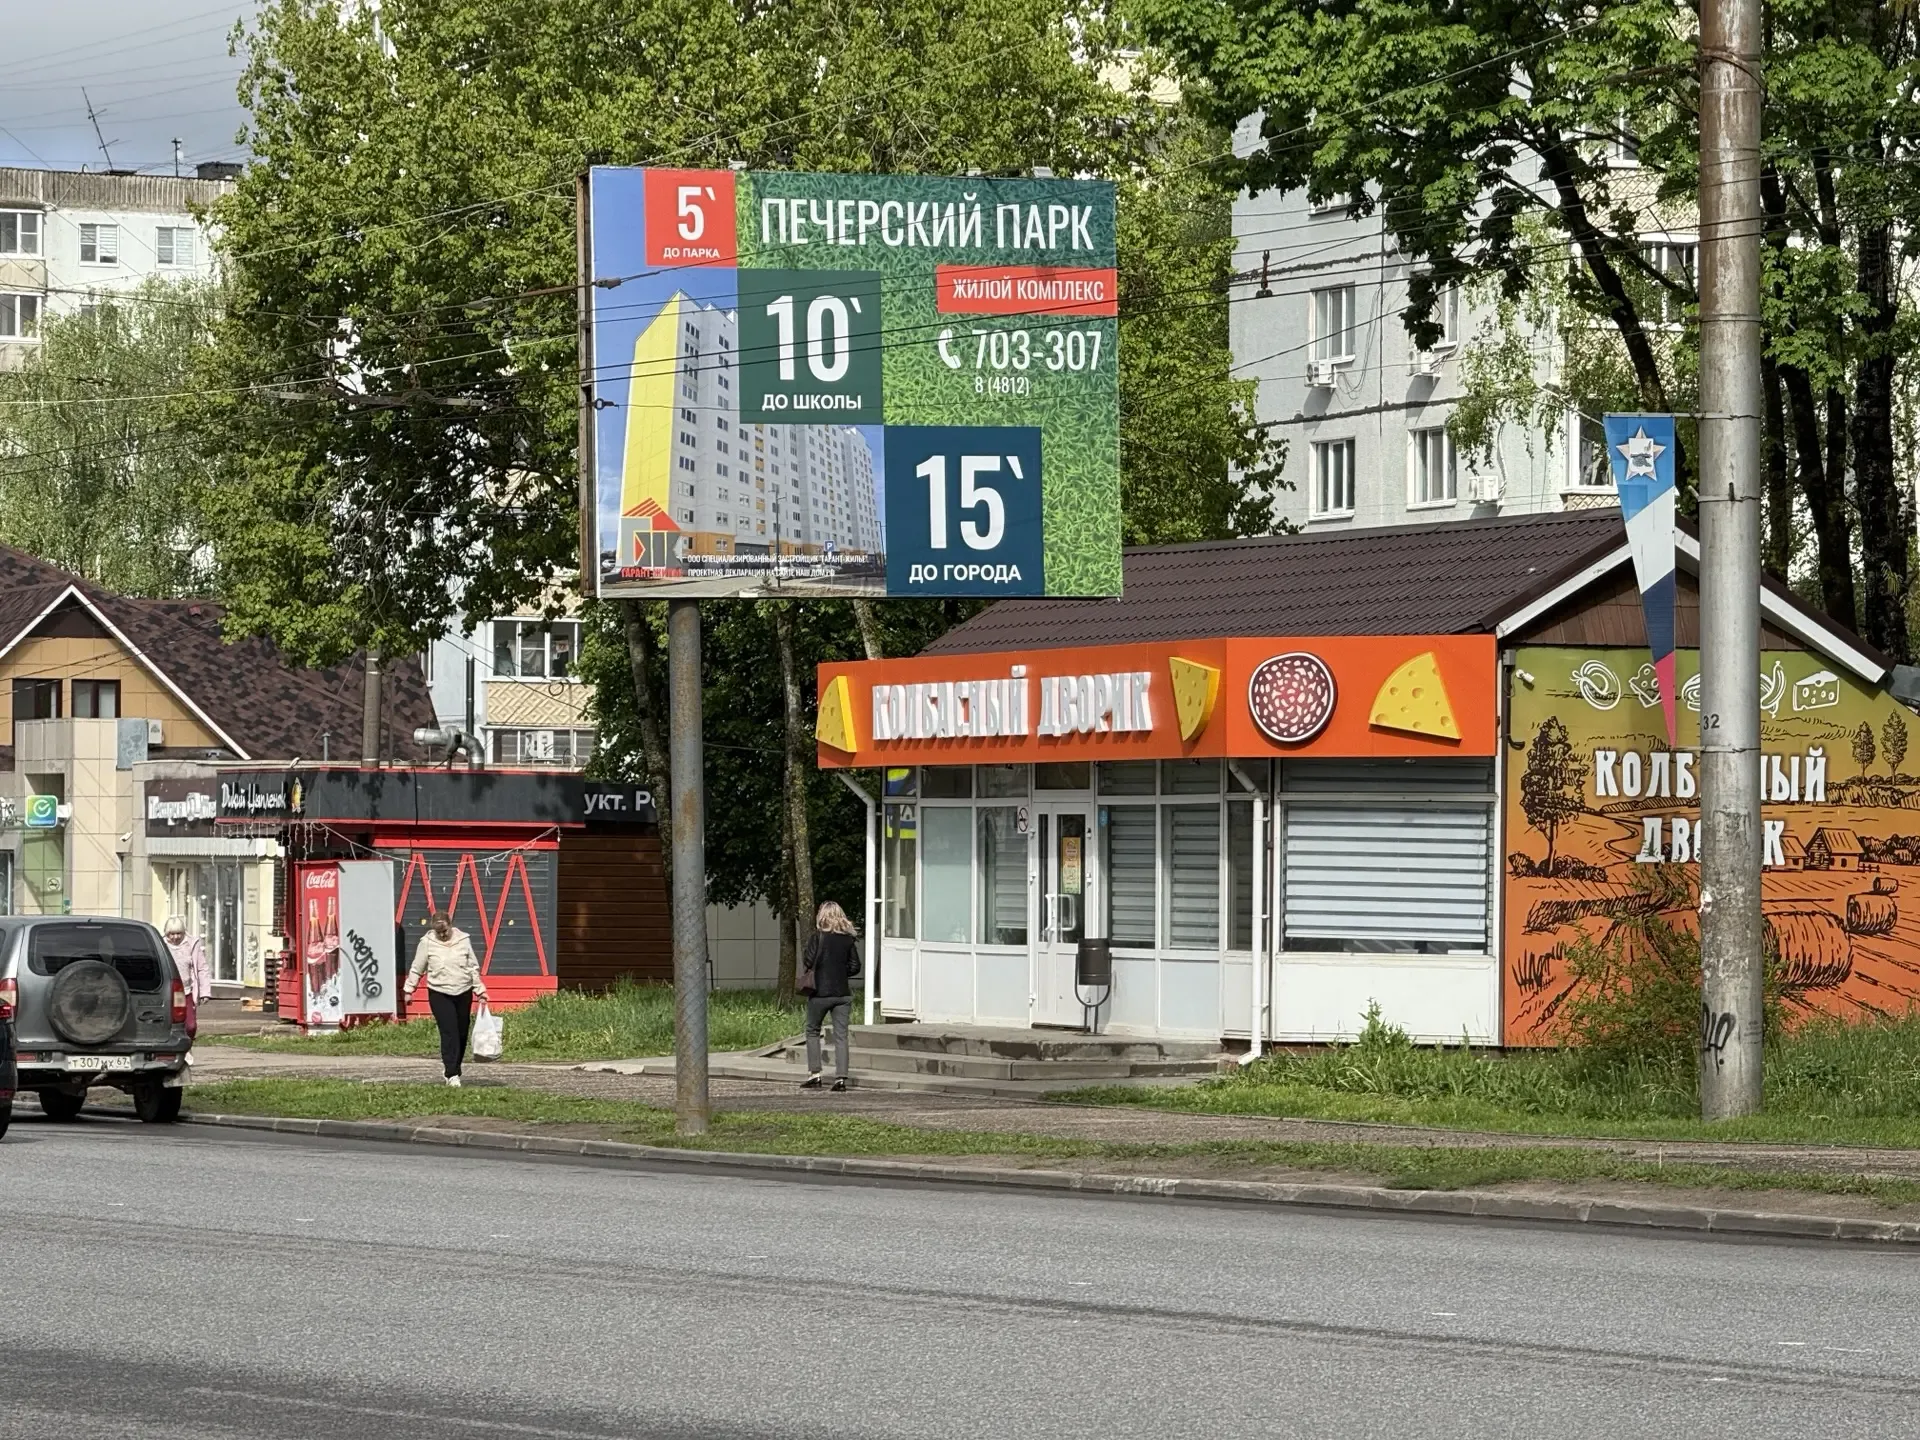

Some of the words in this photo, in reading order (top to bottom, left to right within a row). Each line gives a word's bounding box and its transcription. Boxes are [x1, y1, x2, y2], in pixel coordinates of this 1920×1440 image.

[761, 192, 982, 249] ПЕЧЕРСКИЙ
[996, 203, 1095, 251] ПАРК
[663, 247, 680, 259] ДО
[683, 247, 720, 259] ПАРКА
[952, 275, 1012, 301] ЖИЛОЙ
[1017, 279, 1105, 302] КОМПЛЕКС
[972, 328, 1103, 372] 703-307
[974, 376, 985, 393] 8
[987, 375, 1030, 398] (4812)
[762, 394, 789, 411] ДО
[793, 393, 863, 410] ШКОЛЫ
[687, 555, 701, 563] ООО
[701, 552, 776, 565] СПЕЦИАЛИЗИРОВАННЫЙ
[687, 568, 723, 577] ПРОЕКТНАЯ
[724, 568, 765, 578] ДЕКЛАРАЦИЯ
[909, 564, 938, 584] ДО
[943, 564, 1022, 584] ГОРОДА
[872, 664, 1029, 741] КОЛБАСНЫЙ
[1037, 671, 1153, 737] ДВОРИК
[1703, 713, 1720, 731] 32
[1595, 746, 1827, 802] КОЛБЫЙ
[635, 790, 657, 811] Р
[1635, 817, 1786, 866] ДВК
